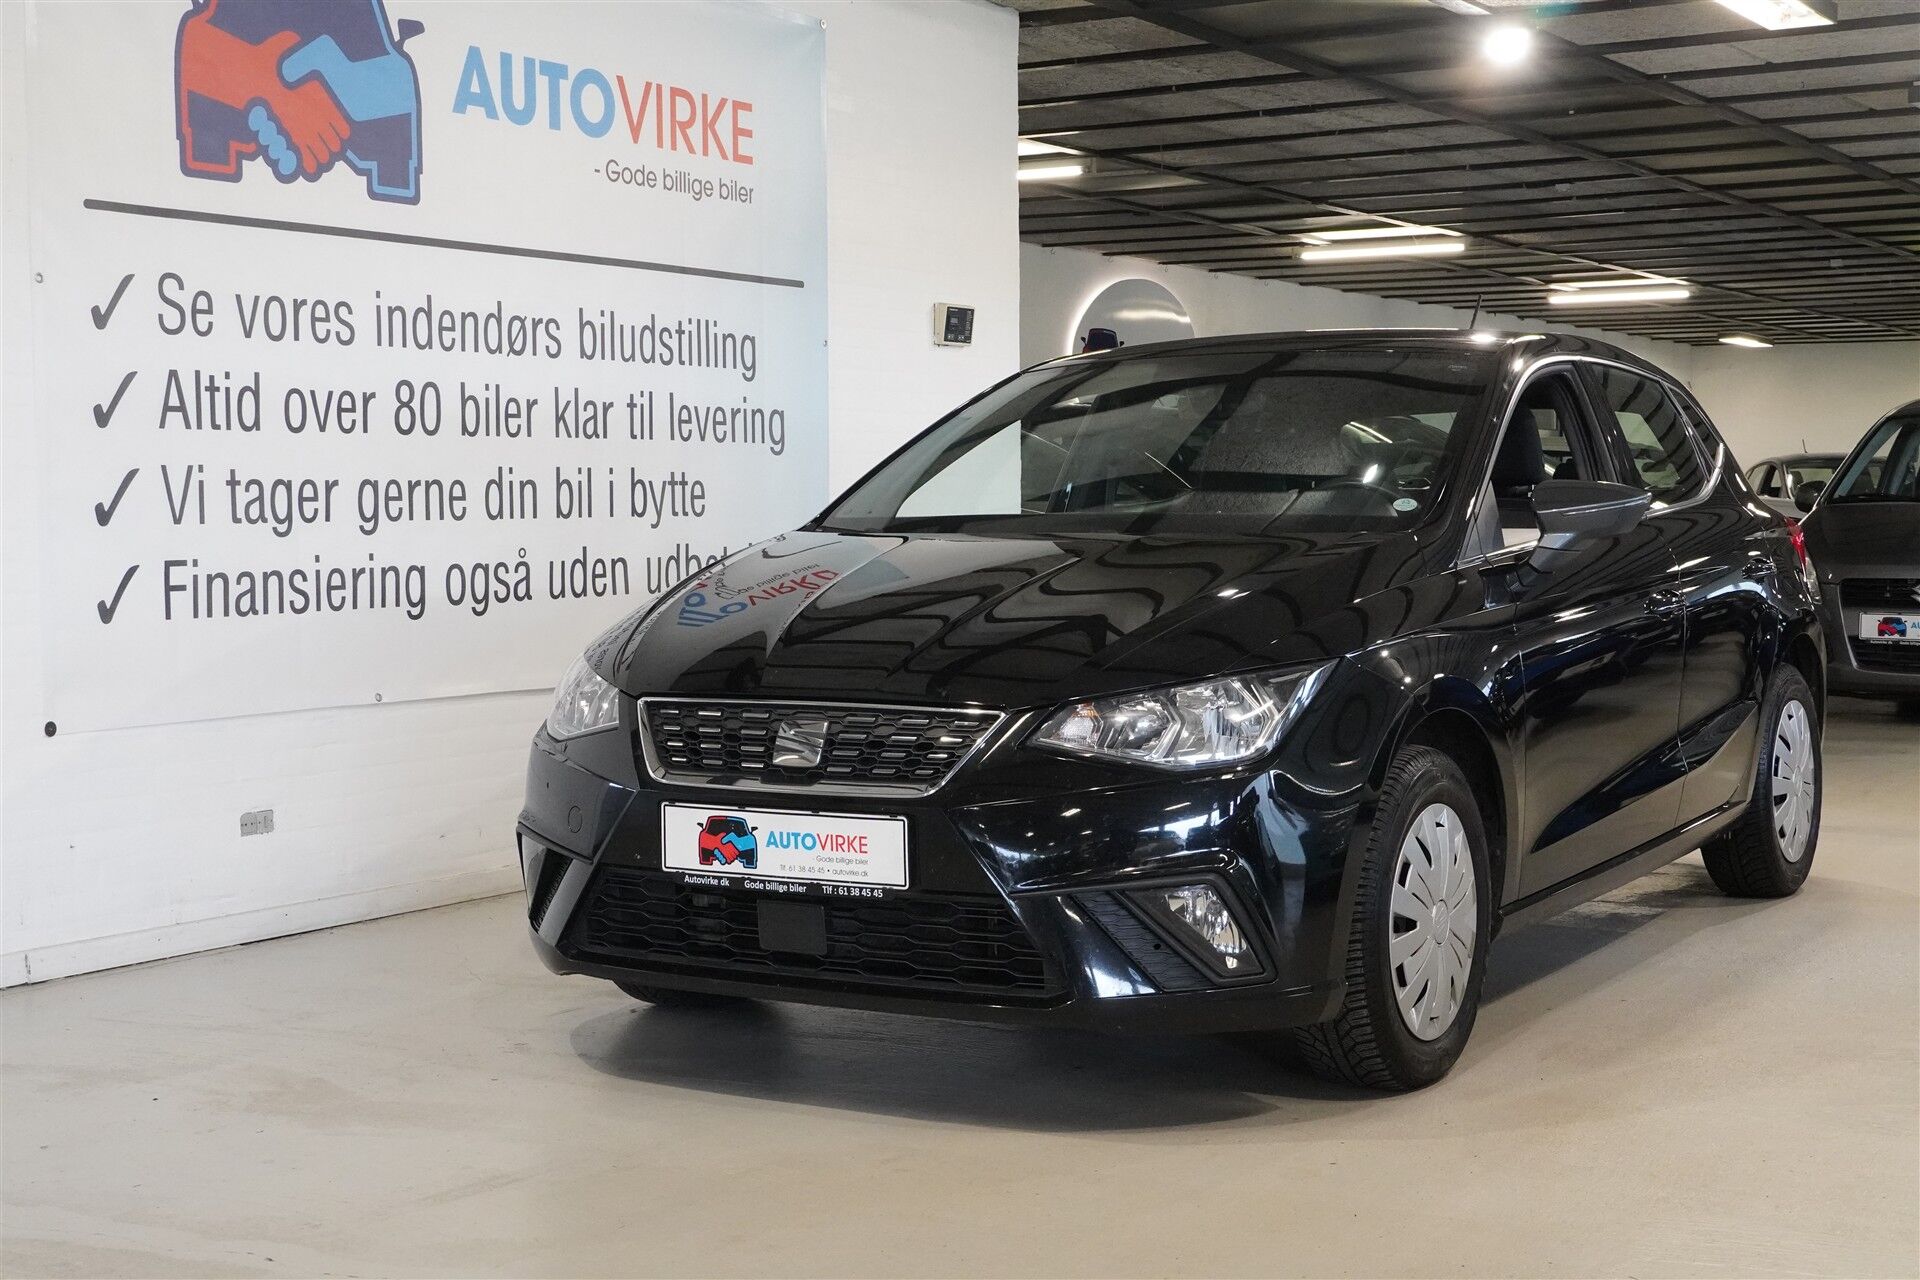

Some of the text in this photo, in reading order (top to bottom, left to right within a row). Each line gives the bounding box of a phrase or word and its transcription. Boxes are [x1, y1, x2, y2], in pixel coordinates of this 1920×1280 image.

[452, 45, 754, 166] AUTOVIRKE
[605, 158, 658, 189] Gode
[662, 167, 714, 201] billige
[718, 177, 754, 204] biler
[157, 272, 757, 382] Se vores indendørs biludstilling
[158, 369, 786, 457] Altid over 80 biler klar til levering
[160, 464, 706, 538] Vi tager gerne din bil i bytte
[163, 553, 426, 622] Finansiering
[445, 547, 533, 617] også
[549, 545, 630, 601] uden
[766, 830, 868, 854] AUTOVIRKE
[816, 854, 835, 863] Gode
[744, 880, 764, 890] Gode
[765, 880, 788, 893] billige
[789, 883, 807, 893] biler
[838, 886, 849, 896] 61
[849, 887, 860, 896] 38
[861, 888, 872, 897] 45
[873, 889, 884, 898] 45
